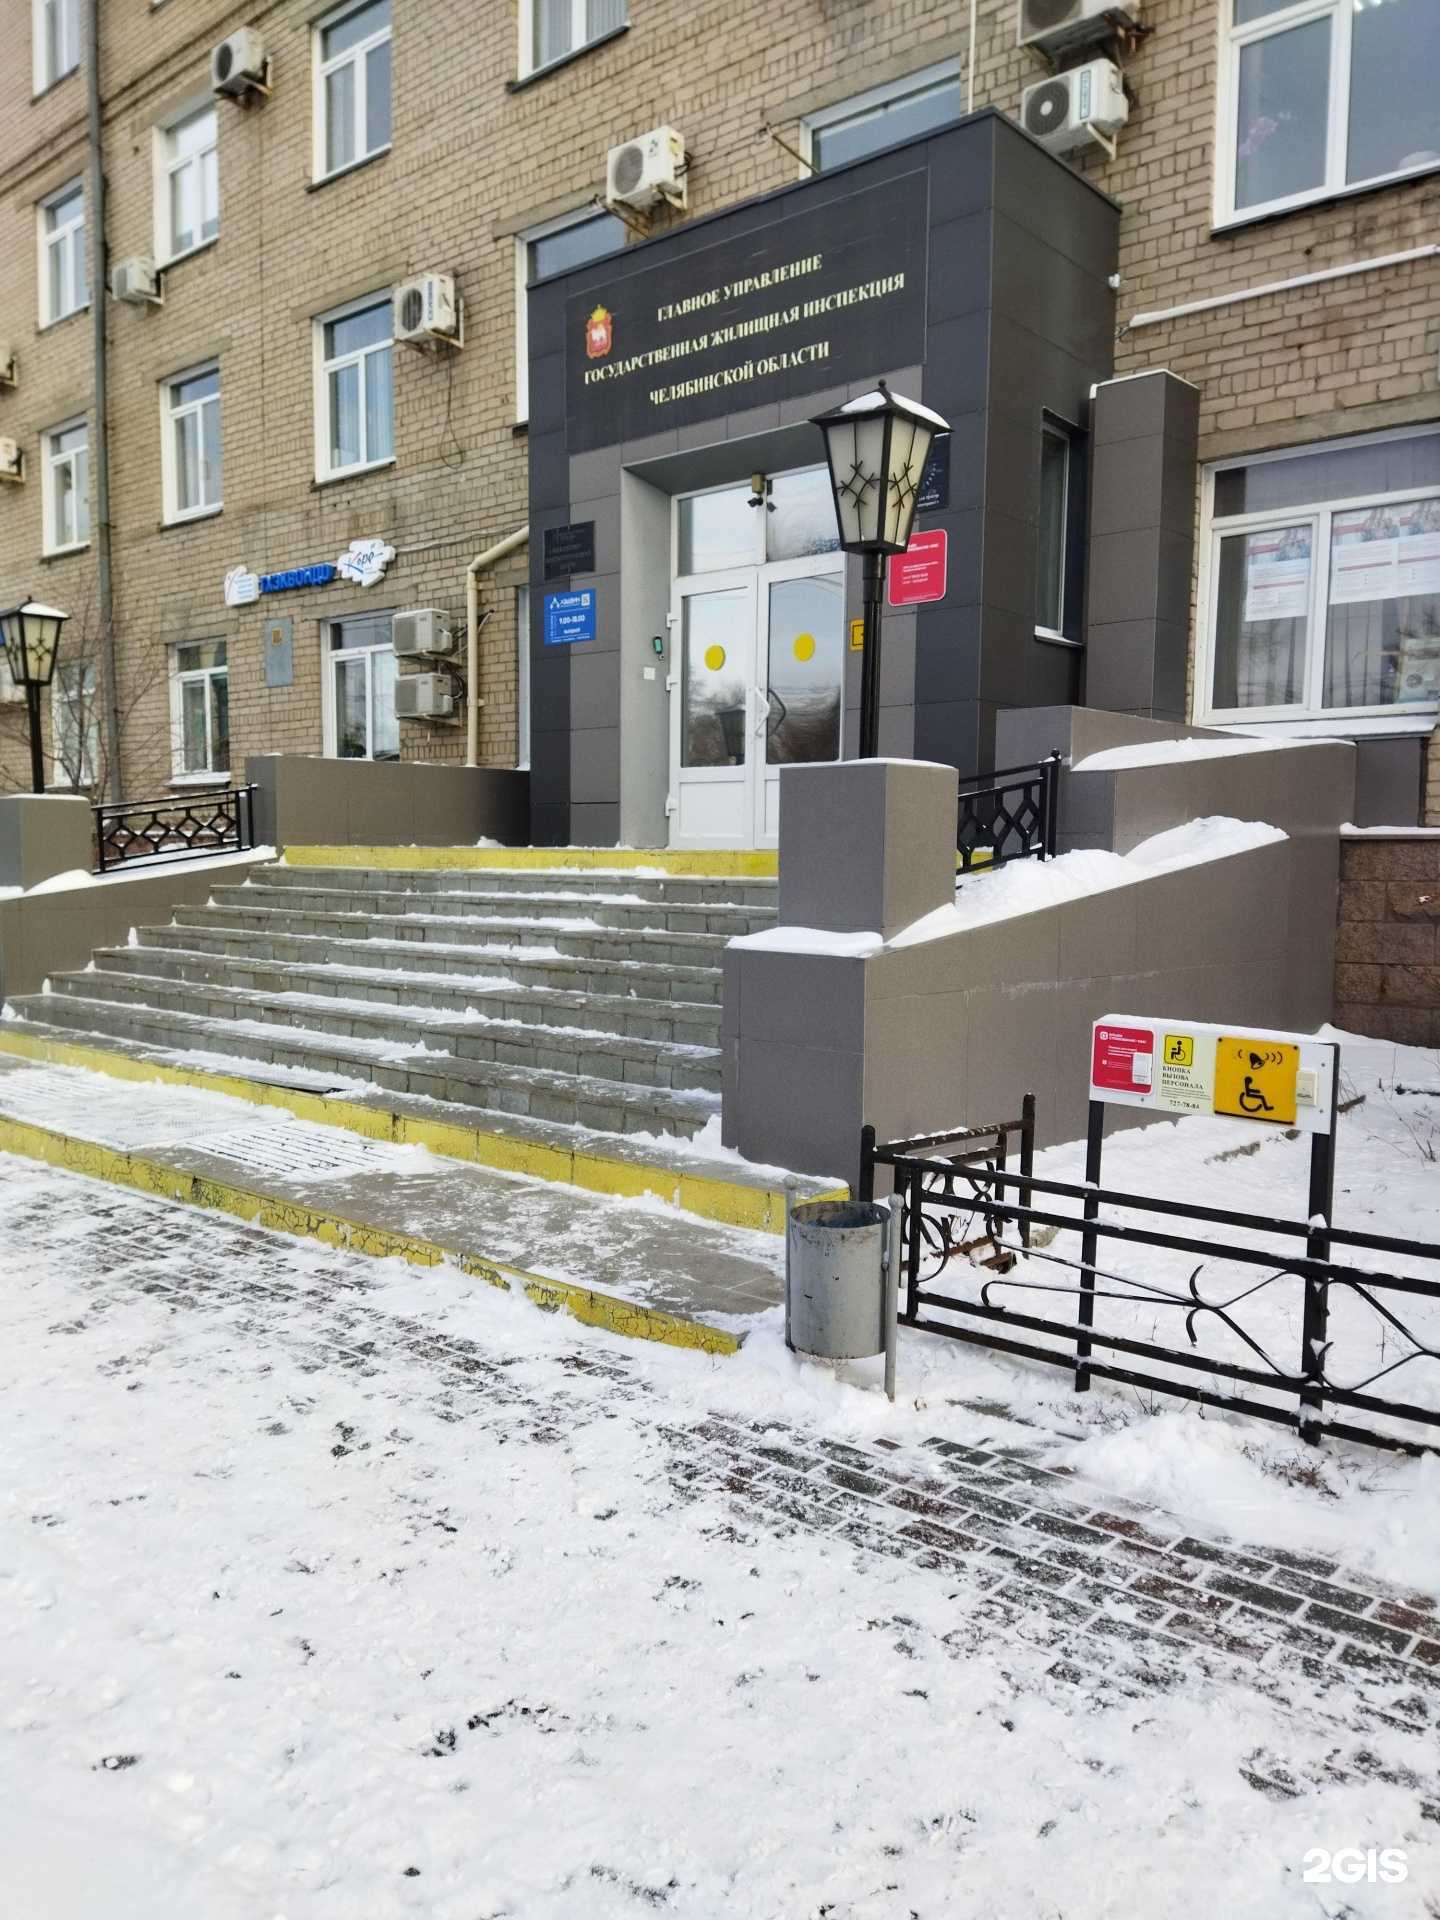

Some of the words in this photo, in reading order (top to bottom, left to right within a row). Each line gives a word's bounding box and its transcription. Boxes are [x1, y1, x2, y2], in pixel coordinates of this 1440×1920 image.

[657, 289, 720, 322] ГЛАВНОЕ
[724, 254, 822, 301] УПРАВЛЕНИЕ
[584, 334, 708, 385] ГОСУДАРСТВЕННАЯ
[711, 306, 800, 347] ЖИЛИЩНАЯ
[803, 273, 905, 318] ИНСПЕКЦИЯ
[650, 361, 754, 405] ЧЕЛЯБИНСКОЙ
[757, 341, 830, 376] ОБЛАСТИ
[1161, 1080, 1204, 1090] ПЕРСОНАЛА
[1162, 1066, 1191, 1075] КНОПКА
[1162, 1073, 1189, 1081] ВЫЗОВА
